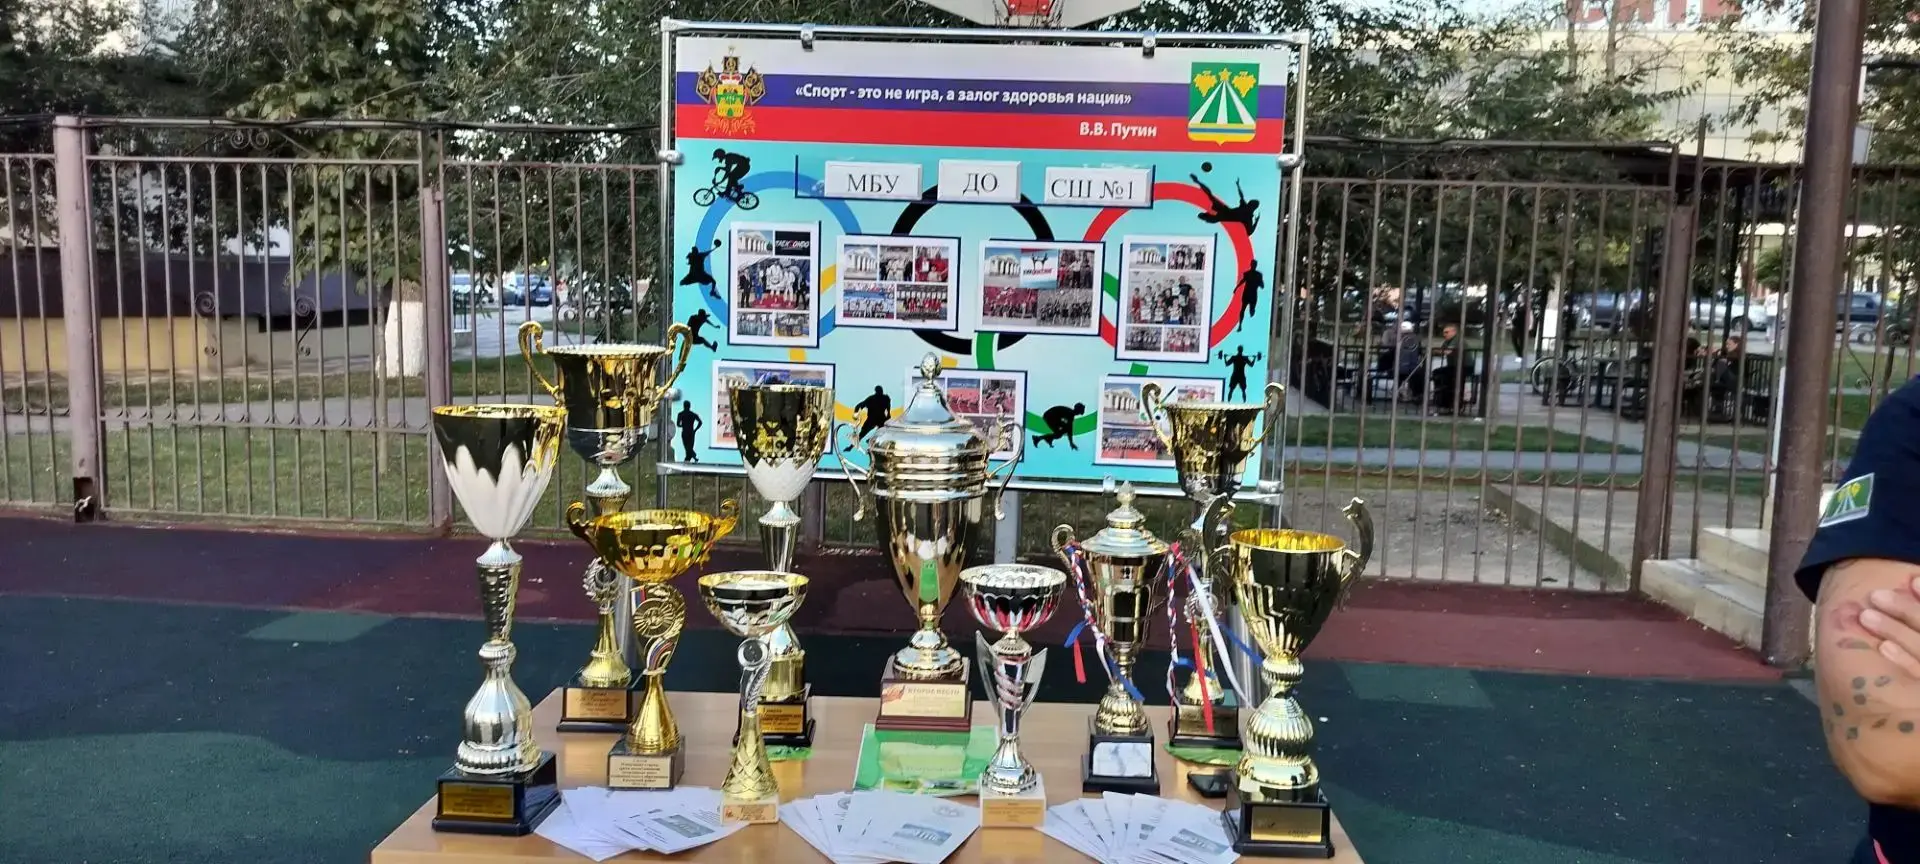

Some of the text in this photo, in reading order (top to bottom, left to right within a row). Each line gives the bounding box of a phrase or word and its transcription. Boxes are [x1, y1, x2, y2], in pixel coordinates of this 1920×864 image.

[796, 83, 847, 101] «Спорт
[857, 87, 882, 99] это
[885, 88, 902, 99] не
[906, 89, 943, 103] игра,
[946, 92, 955, 101] а
[957, 91, 999, 103] залог
[1002, 91, 1074, 106] здоровья
[1077, 92, 1132, 107] нации»
[1079, 121, 1157, 139] В.В. Путин
[847, 172, 1133, 199] МБУ ДО СШ №1
